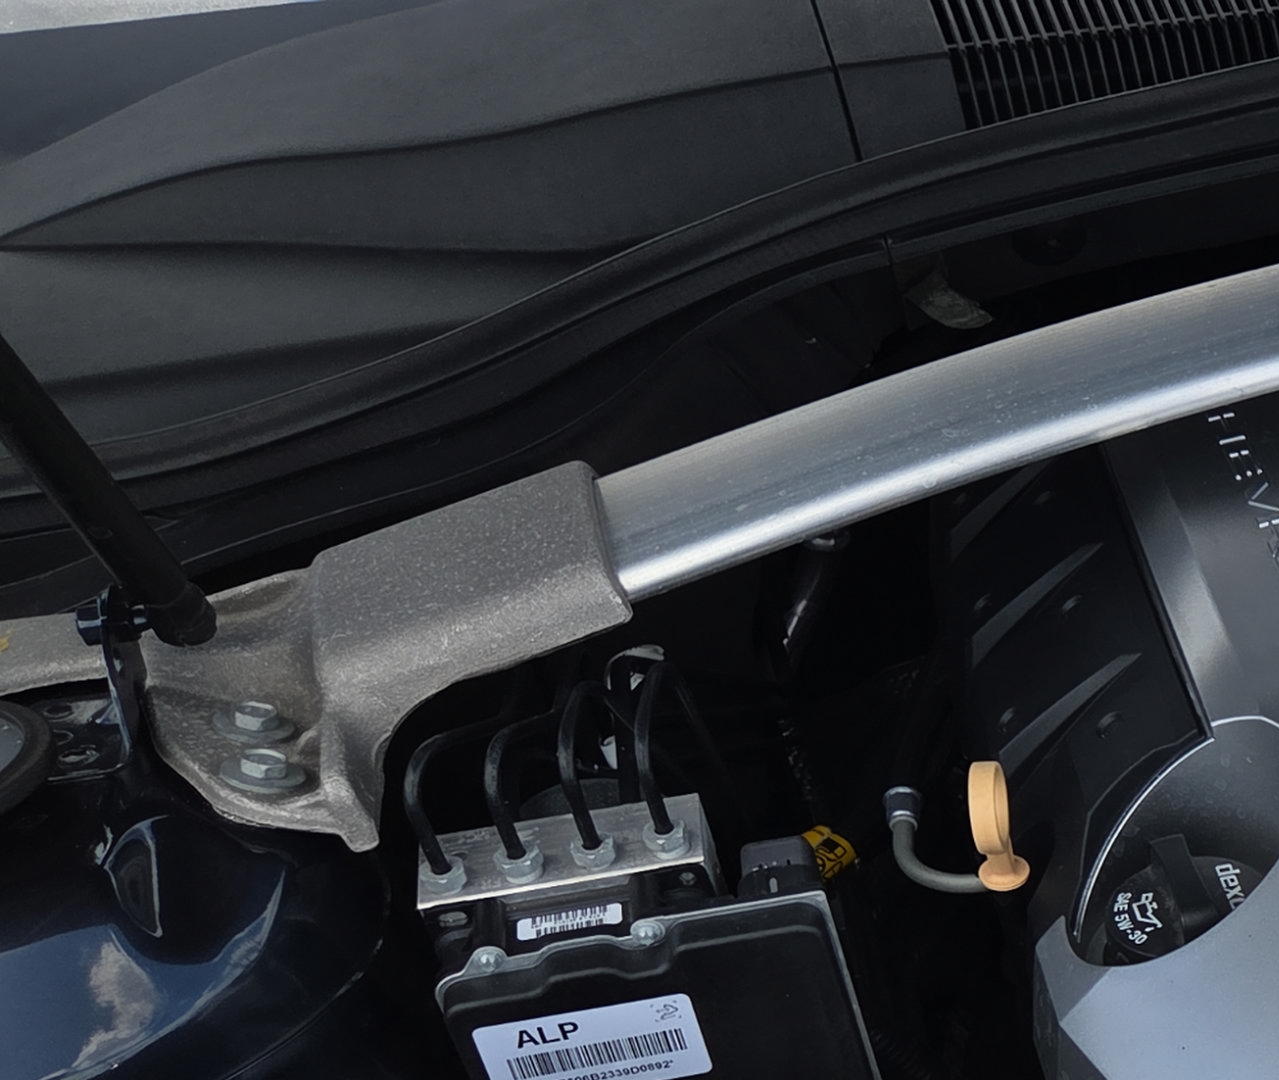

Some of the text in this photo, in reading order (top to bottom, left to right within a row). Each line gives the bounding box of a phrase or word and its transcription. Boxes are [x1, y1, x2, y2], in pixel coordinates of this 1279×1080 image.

[1113, 891, 1149, 945] SAE 5W-30
[517, 1020, 580, 1049] ALP
